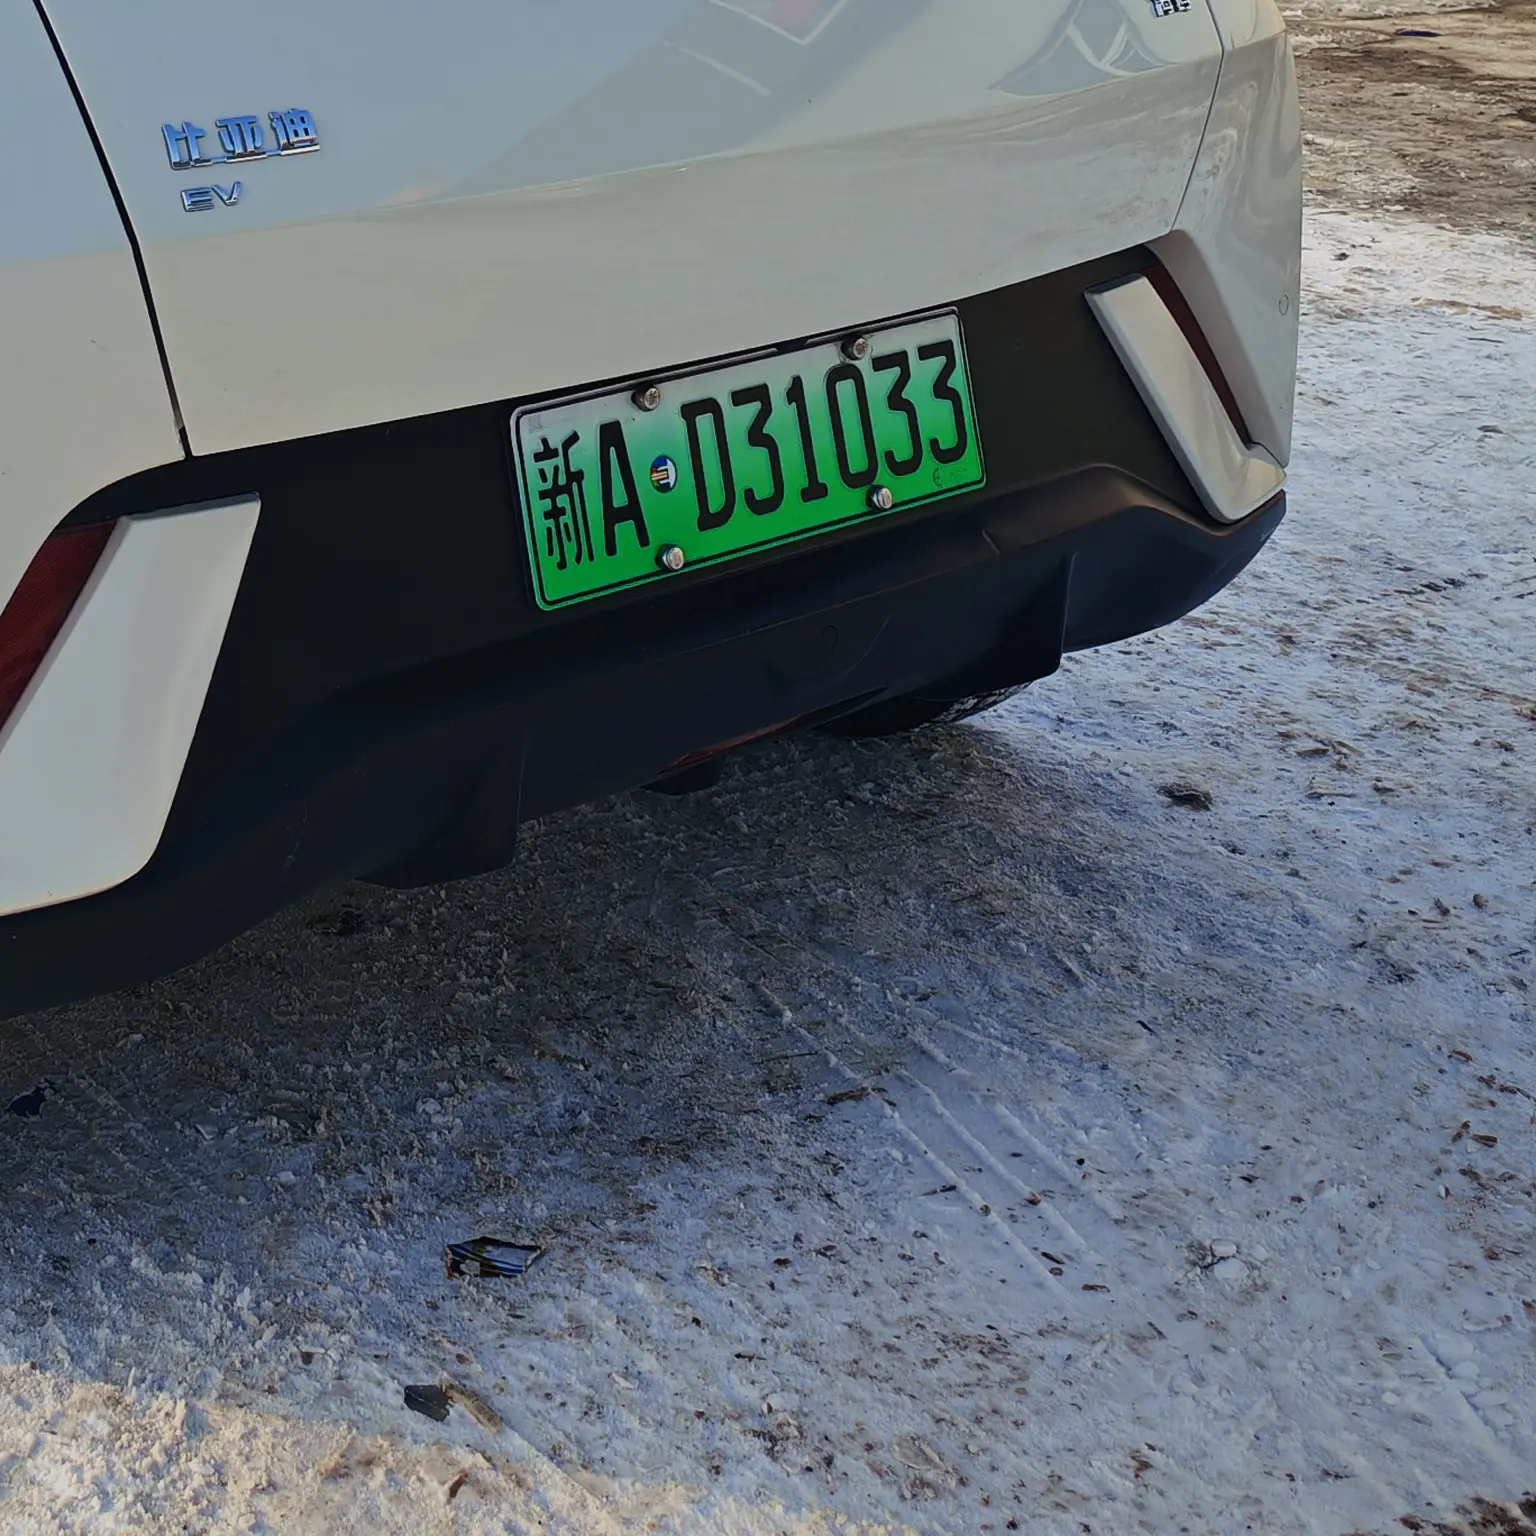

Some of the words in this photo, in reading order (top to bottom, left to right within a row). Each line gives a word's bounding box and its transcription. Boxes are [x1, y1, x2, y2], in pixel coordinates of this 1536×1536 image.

[161, 108, 321, 171] 比亚迪
[181, 181, 242, 212] EV
